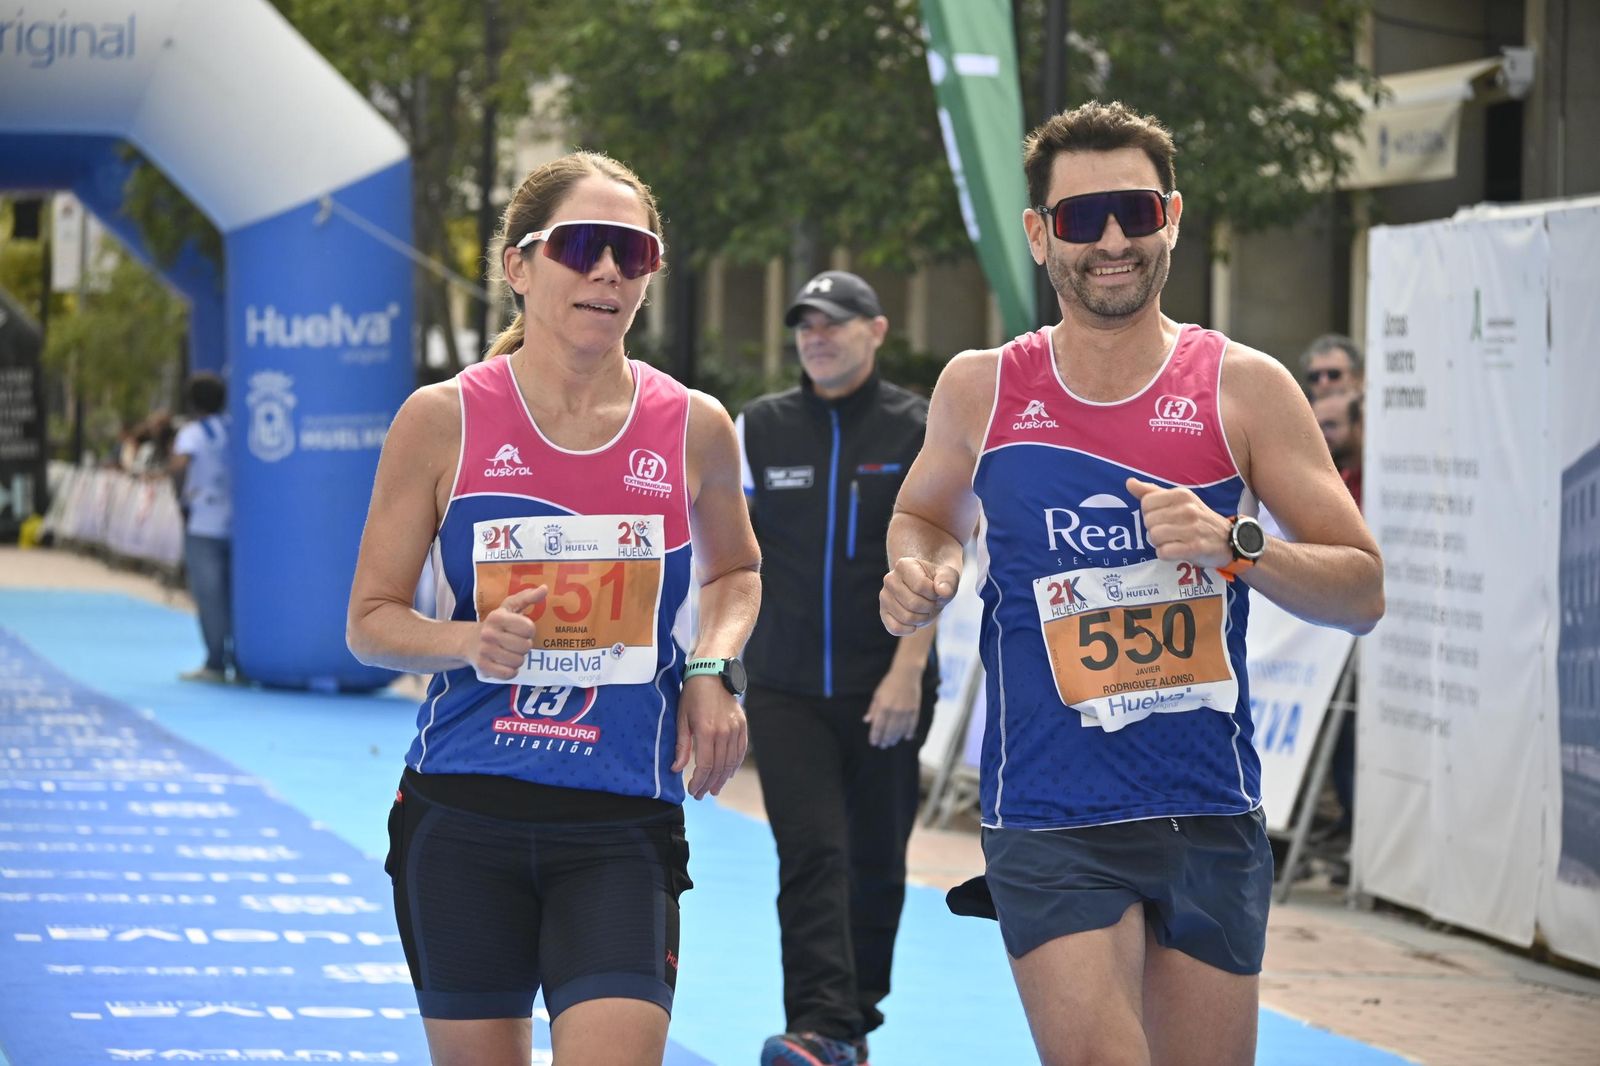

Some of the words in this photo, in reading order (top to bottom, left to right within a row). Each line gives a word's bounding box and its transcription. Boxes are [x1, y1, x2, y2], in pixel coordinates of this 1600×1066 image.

[246, 304, 393, 348] Huelva
[1162, 399, 1188, 419] t3
[1013, 420, 1060, 431] austral
[1150, 419, 1202, 430] EXTREMADURA
[301, 428, 386, 450] HUELV
[484, 467, 533, 477] austral
[636, 457, 659, 480] t3
[624, 477, 671, 491] EXTREMADURA
[1044, 508, 1156, 554] Real
[485, 549, 524, 560] HUELVA
[565, 544, 599, 552] HUELVA
[618, 547, 653, 558] HUELVA
[1176, 562, 1213, 586] 21K
[508, 562, 625, 624] 551
[1047, 576, 1087, 606] 21K
[1126, 587, 1160, 599] HUELVA
[1179, 583, 1215, 598] HUELVA
[1051, 600, 1089, 618] HUELVA
[555, 626, 589, 634] MARIANA
[1079, 603, 1196, 672] 550
[544, 638, 597, 648] CARRETERO
[527, 650, 602, 673] Huelva
[1135, 665, 1161, 676] JAVIER
[1103, 678, 1158, 694] RODRIGUEZ
[1160, 674, 1195, 687] ALONSO
[522, 685, 573, 716] t3
[1108, 690, 1185, 717] Huelva
[494, 720, 597, 741] EXTREMADURA
[494, 734, 593, 757] triatlón
